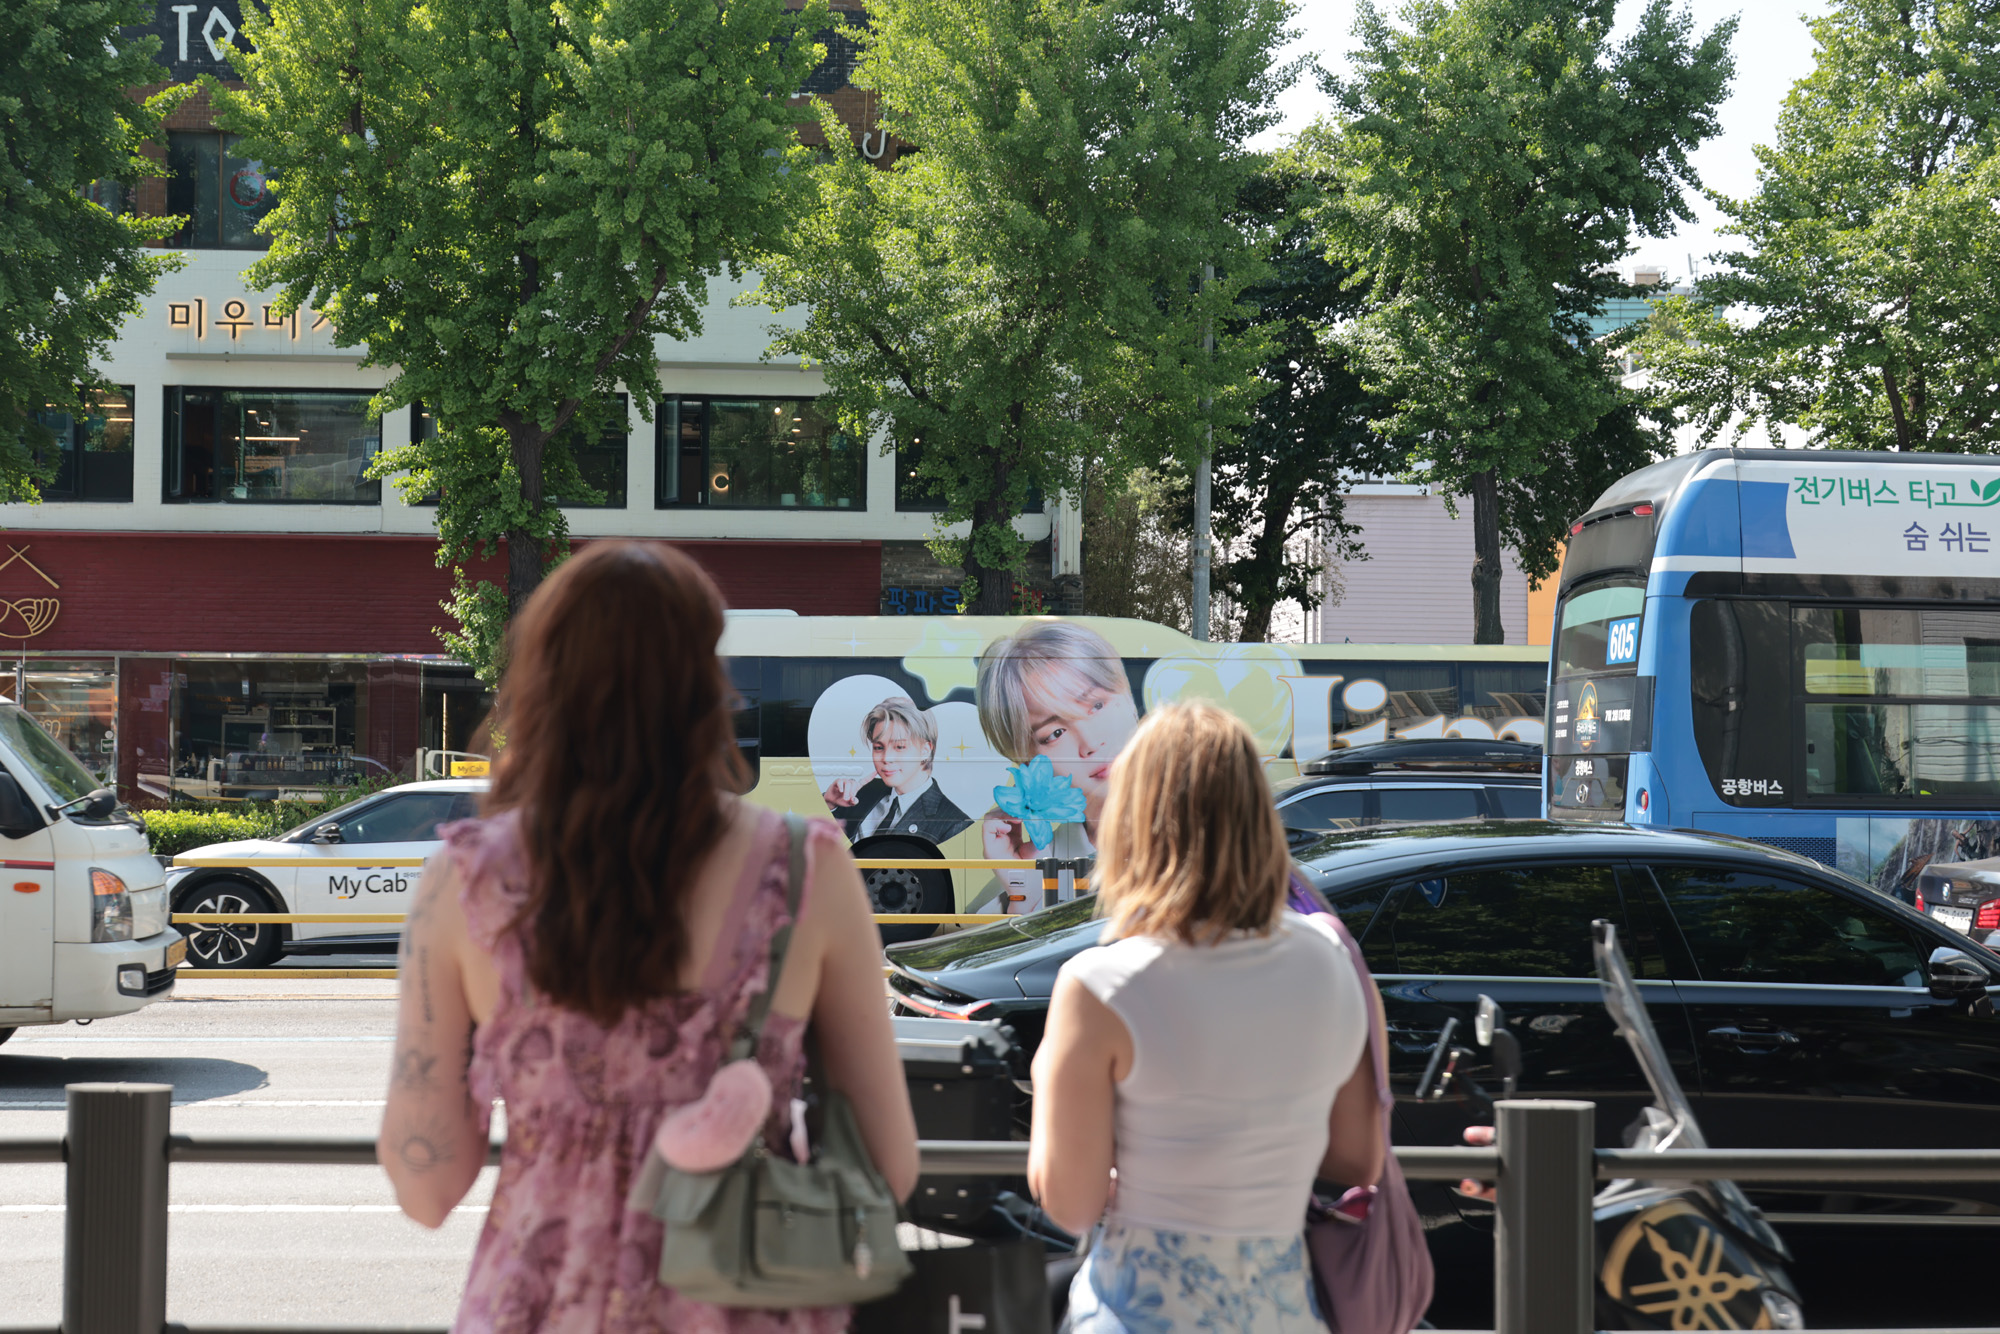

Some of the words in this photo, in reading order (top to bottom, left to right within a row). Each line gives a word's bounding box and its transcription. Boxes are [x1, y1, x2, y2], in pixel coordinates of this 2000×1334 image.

[168, 298, 334, 340] 미우미
[1794, 475, 1900, 507] 전기버스
[1908, 479, 1956, 509] 타고
[1903, 521, 1929, 551] 숨
[1938, 521, 1991, 552] 쉬는
[1610, 623, 1635, 661] 605
[1575, 760, 1593, 776] 공항버스
[1721, 778, 1784, 796] 공항버스
